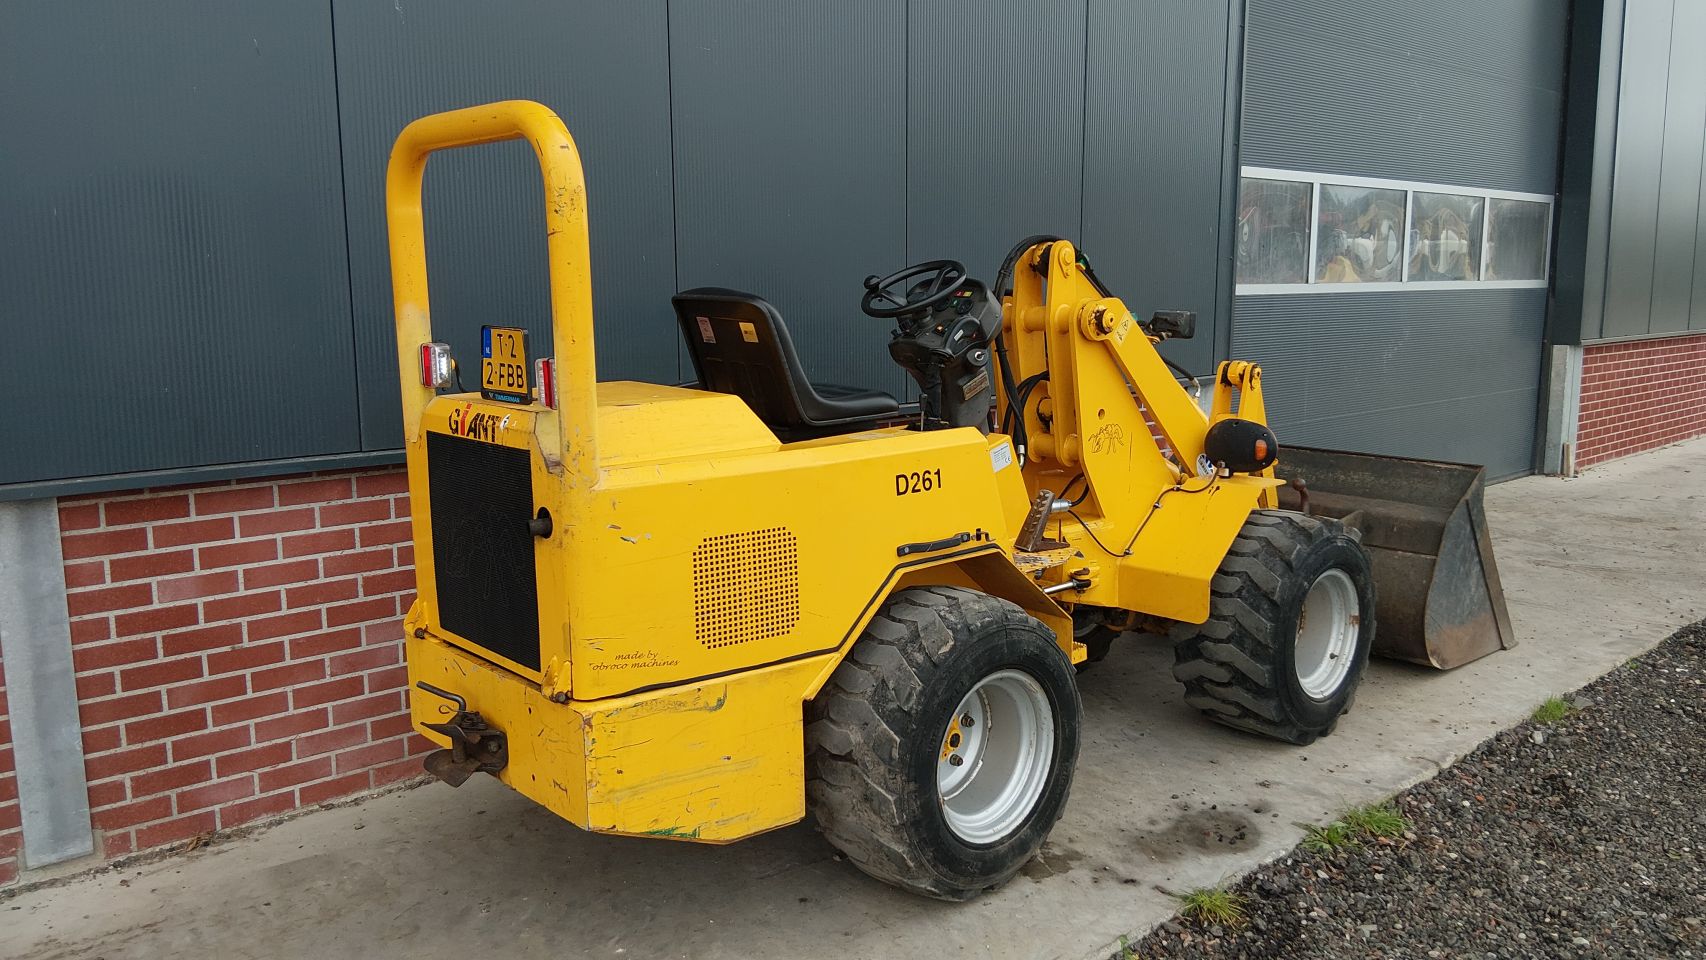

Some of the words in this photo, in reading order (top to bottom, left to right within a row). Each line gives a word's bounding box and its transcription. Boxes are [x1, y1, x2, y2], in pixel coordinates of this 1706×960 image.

[895, 468, 942, 496] D261
[614, 651, 644, 661] made
[646, 650, 658, 660] by
[630, 657, 680, 669] machines
